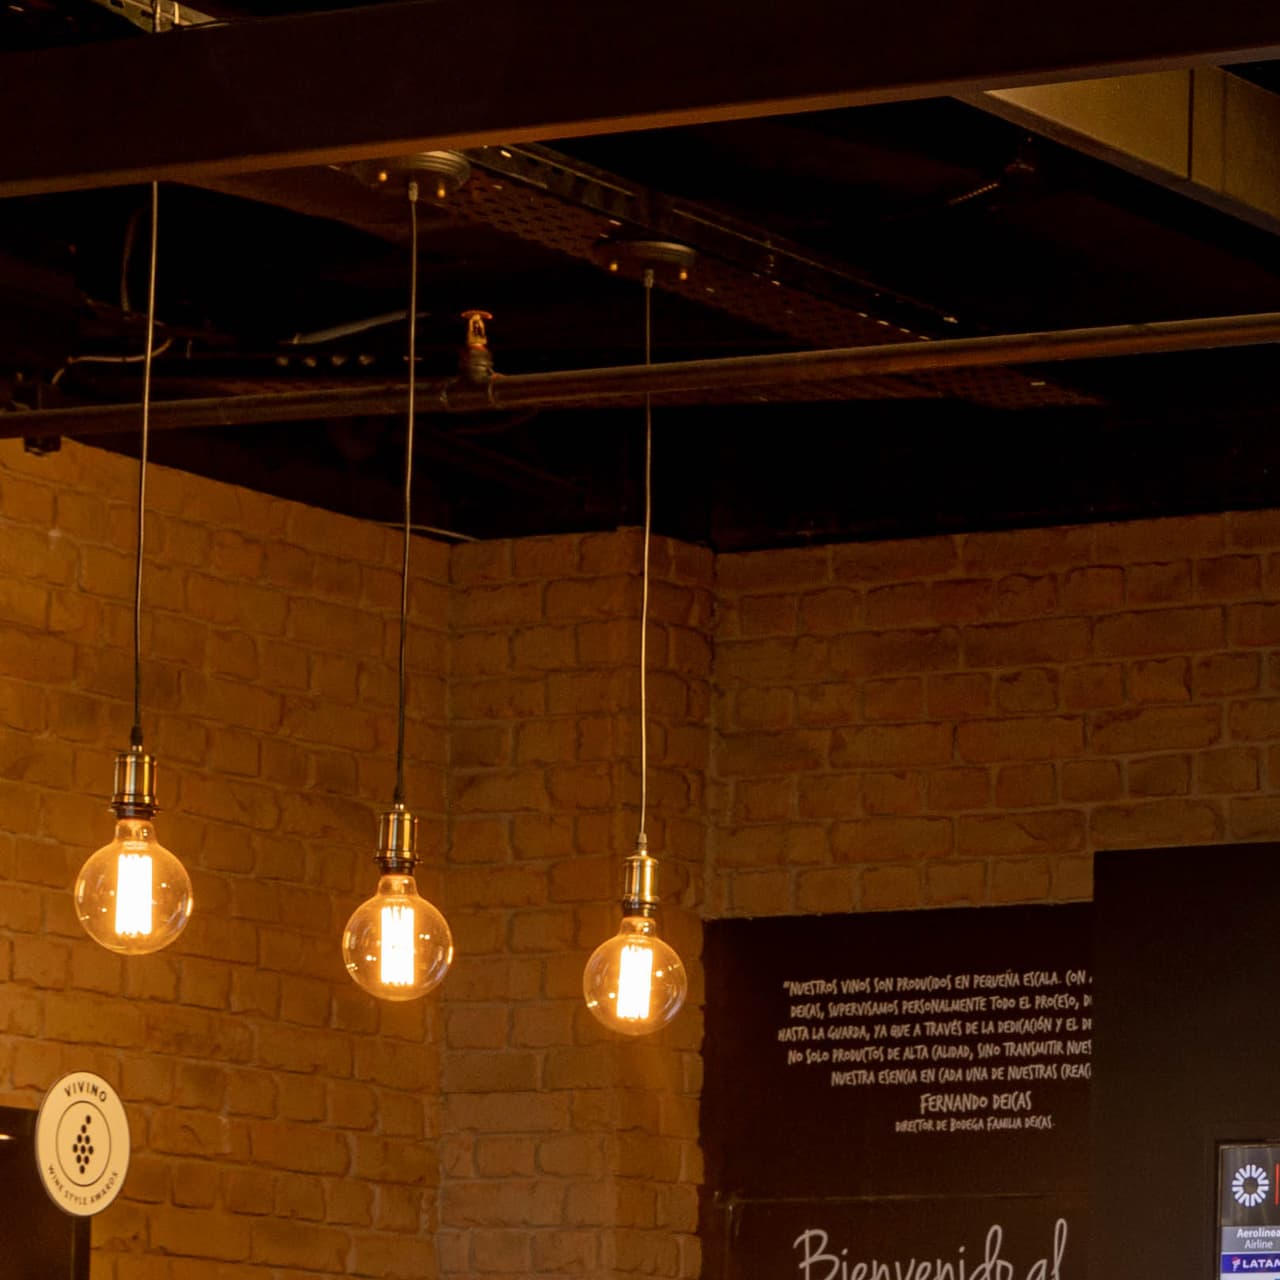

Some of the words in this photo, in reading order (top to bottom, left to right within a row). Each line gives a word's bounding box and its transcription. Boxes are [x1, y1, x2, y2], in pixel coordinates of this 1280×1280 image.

[841, 977, 871, 994] VINOS
[874, 977, 894, 993] SON
[954, 975, 970, 990] EN
[920, 1068, 936, 1083] EN
[991, 1067, 1005, 1081] DE
[64, 1081, 107, 1102] VIVINO
[920, 1092, 988, 1115] FERNANDO
[992, 1090, 1032, 1112] DEICAS
[1244, 1240, 1273, 1249] Airline
